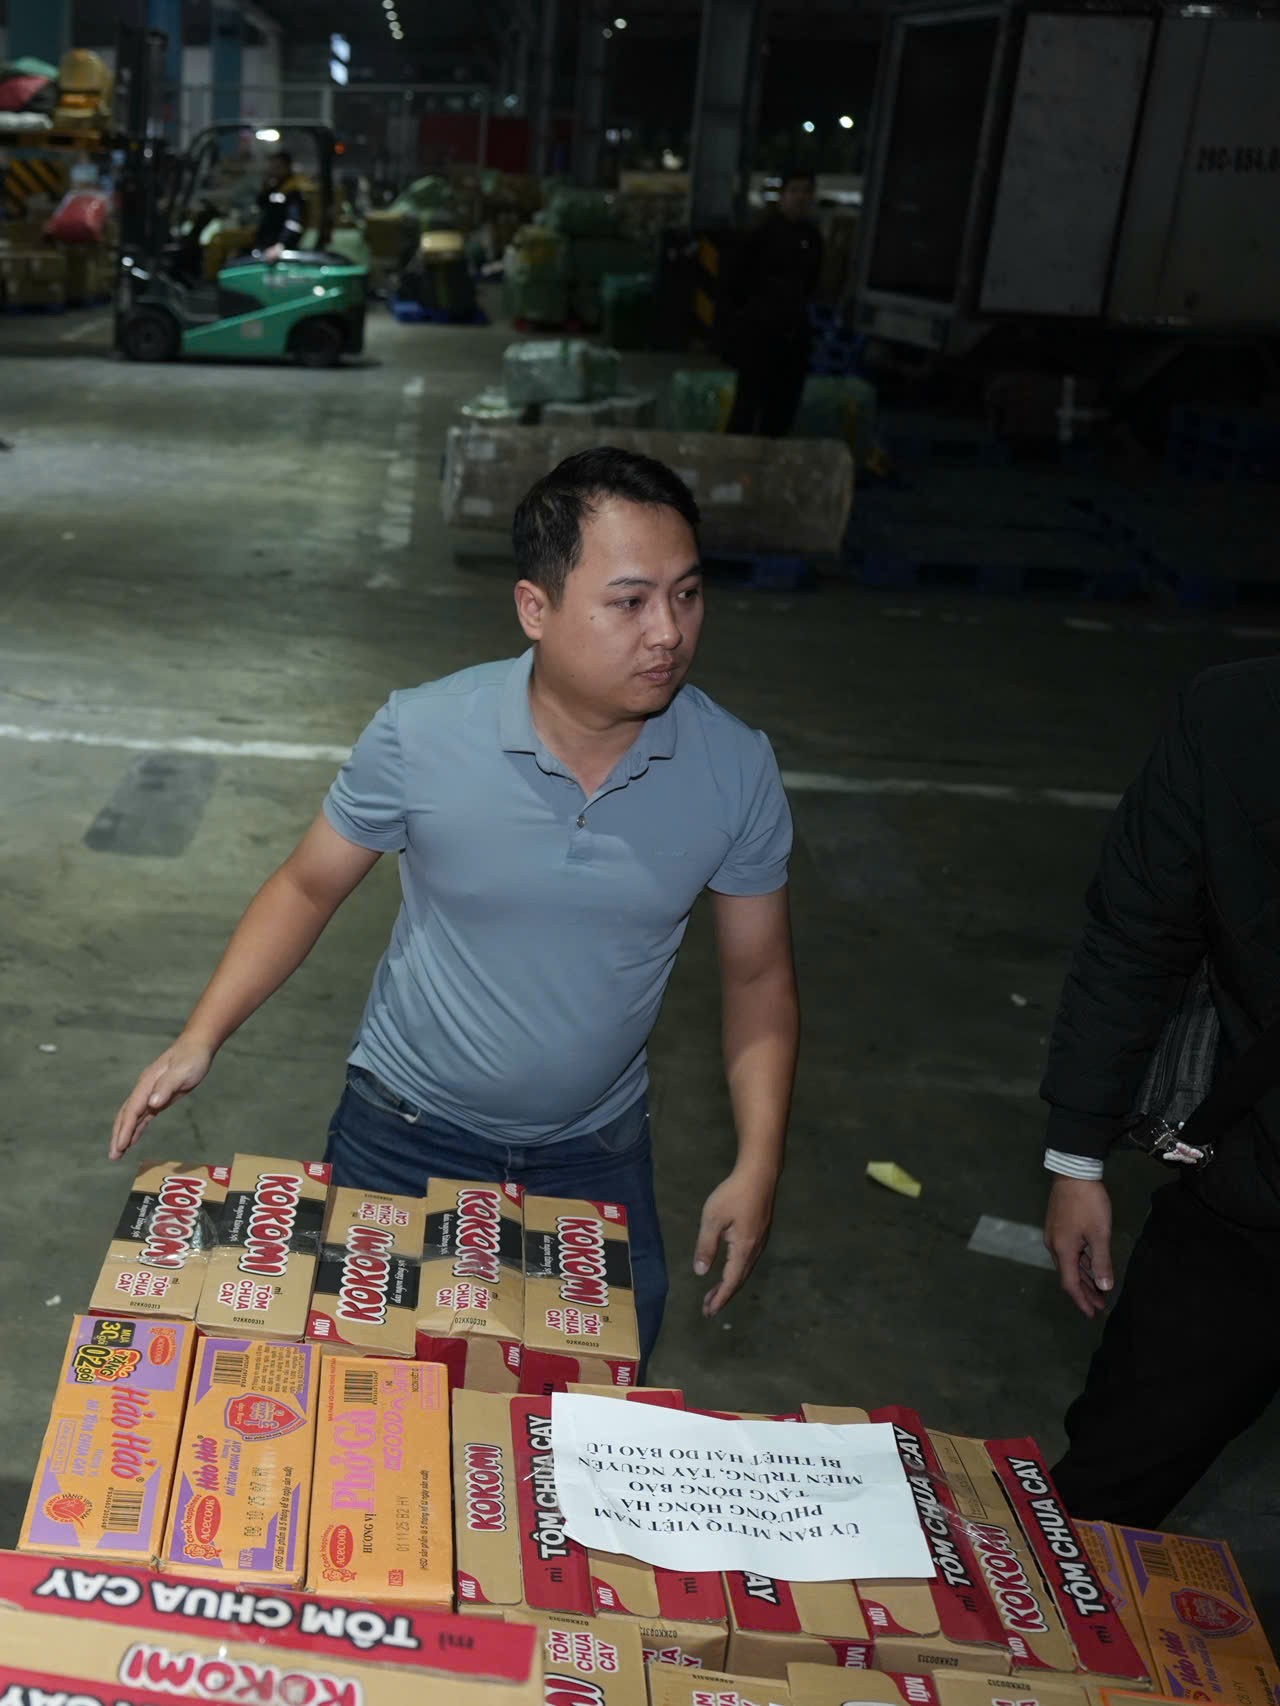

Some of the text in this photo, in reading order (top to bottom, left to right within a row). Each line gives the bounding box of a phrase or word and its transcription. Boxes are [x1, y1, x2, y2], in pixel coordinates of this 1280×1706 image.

[138, 1174, 208, 1270] KOKOMI
[237, 1173, 304, 1277] KOKOMI
[378, 1203, 394, 1227] CHUA
[393, 1208, 410, 1227] CAY
[452, 1188, 501, 1284] KOKOMI
[336, 1224, 395, 1326] KOKOMI
[556, 1215, 610, 1307] KOKOMI
[116, 1271, 133, 1292] CAY
[132, 1270, 152, 1297] CHUA
[151, 1275, 169, 1297] TÔM
[217, 1281, 236, 1305] CAY
[236, 1279, 255, 1311] CHUA
[254, 1284, 273, 1310] TÔM
[435, 1287, 453, 1308] CAY
[453, 1282, 471, 1312] CHUA
[472, 1287, 488, 1311] TÔM
[119, 1327, 133, 1344] MUA
[311, 1318, 330, 1336] MỚI
[545, 1309, 563, 1331] CAY
[564, 1307, 582, 1335] CHUA
[583, 1312, 600, 1337] TÔM
[109, 1384, 157, 1480] Hảo Hảo
[527, 1413, 553, 1452] CAY
[192, 1437, 219, 1491] Hảo Hảo
[329, 1409, 377, 1513] Phở Gà
[578, 1456, 863, 1486] MIỀN TRUNG, TÂY NGUYÊN
[586, 1442, 842, 1469] BỊ THIỆT HẠI DO BÃO LŨ
[464, 1441, 507, 1532] KOKOMI
[628, 1480, 673, 1496] BÀO
[749, 1486, 810, 1504] TẶNG
[619, 1498, 651, 1513] HÀ
[729, 1503, 823, 1524] PHƯỜNG
[183, 1525, 194, 1544] Cook
[362, 1512, 377, 1554] HƯƠNG VỊ
[529, 1508, 570, 1561] TÔM
[594, 1507, 861, 1542] ỦY BAN MTTQ VIỆT NAM
[1005, 1456, 1110, 1618] TÔM CHUA CAY
[549, 1567, 564, 1584] mì
[929, 1534, 975, 1591] TÔM
[970, 1522, 1051, 1636] KOKOMI
[35, 1566, 142, 1605] CAY
[744, 1570, 781, 1607] AY
[152, 1583, 290, 1629] CHUA
[300, 1601, 422, 1652] TÔM
[551, 1630, 571, 1665] TÔM
[573, 1630, 597, 1674] CHUA
[597, 1640, 620, 1674] CAY
[119, 1642, 364, 1706] KOKOMI
